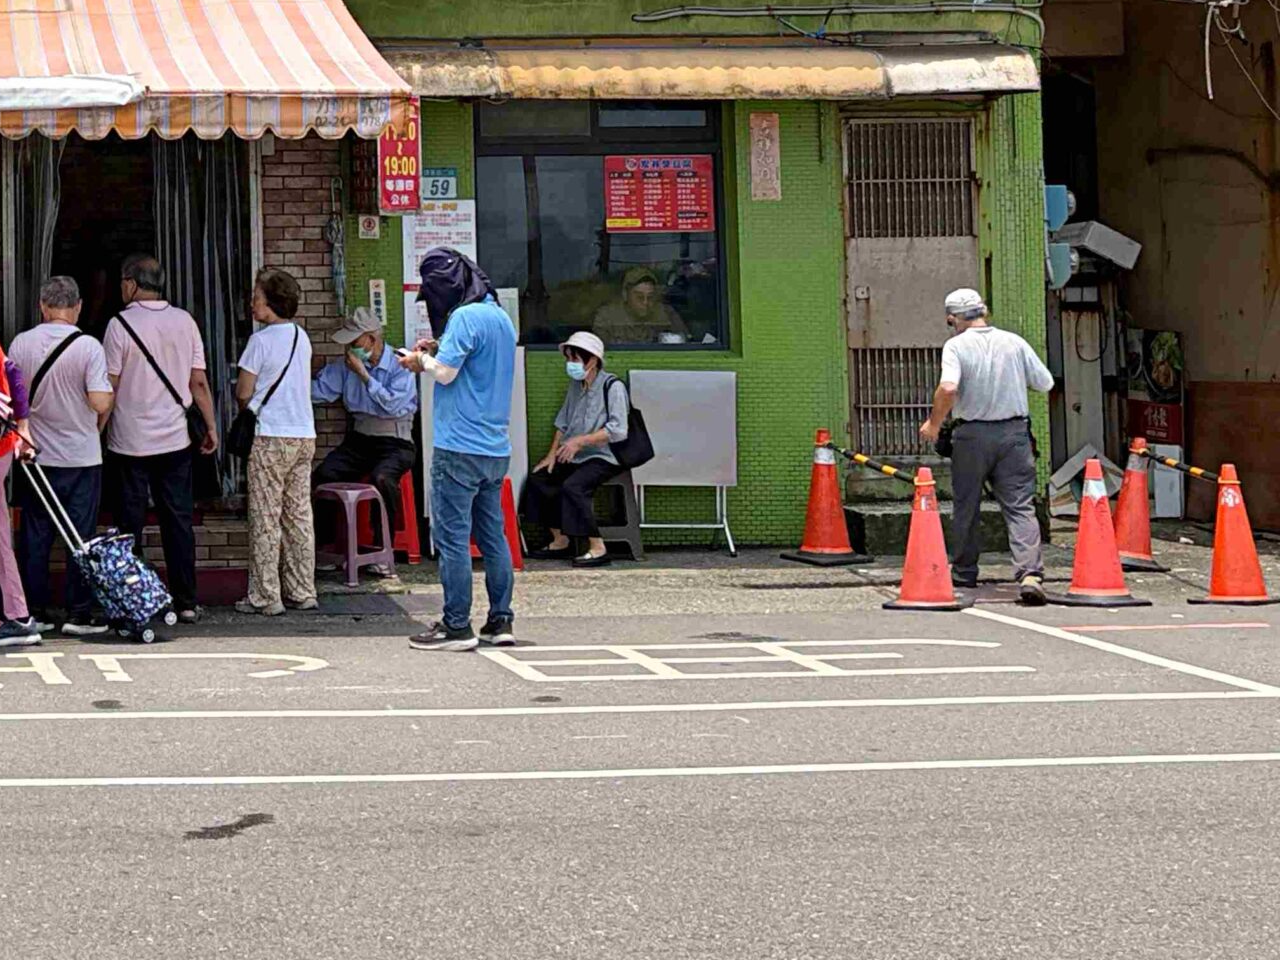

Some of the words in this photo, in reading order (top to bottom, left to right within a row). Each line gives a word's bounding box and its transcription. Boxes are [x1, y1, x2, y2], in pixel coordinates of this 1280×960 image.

[384, 156, 417, 176] 19:00
[429, 179, 450, 196] 59
[390, 194, 410, 205] 公休
